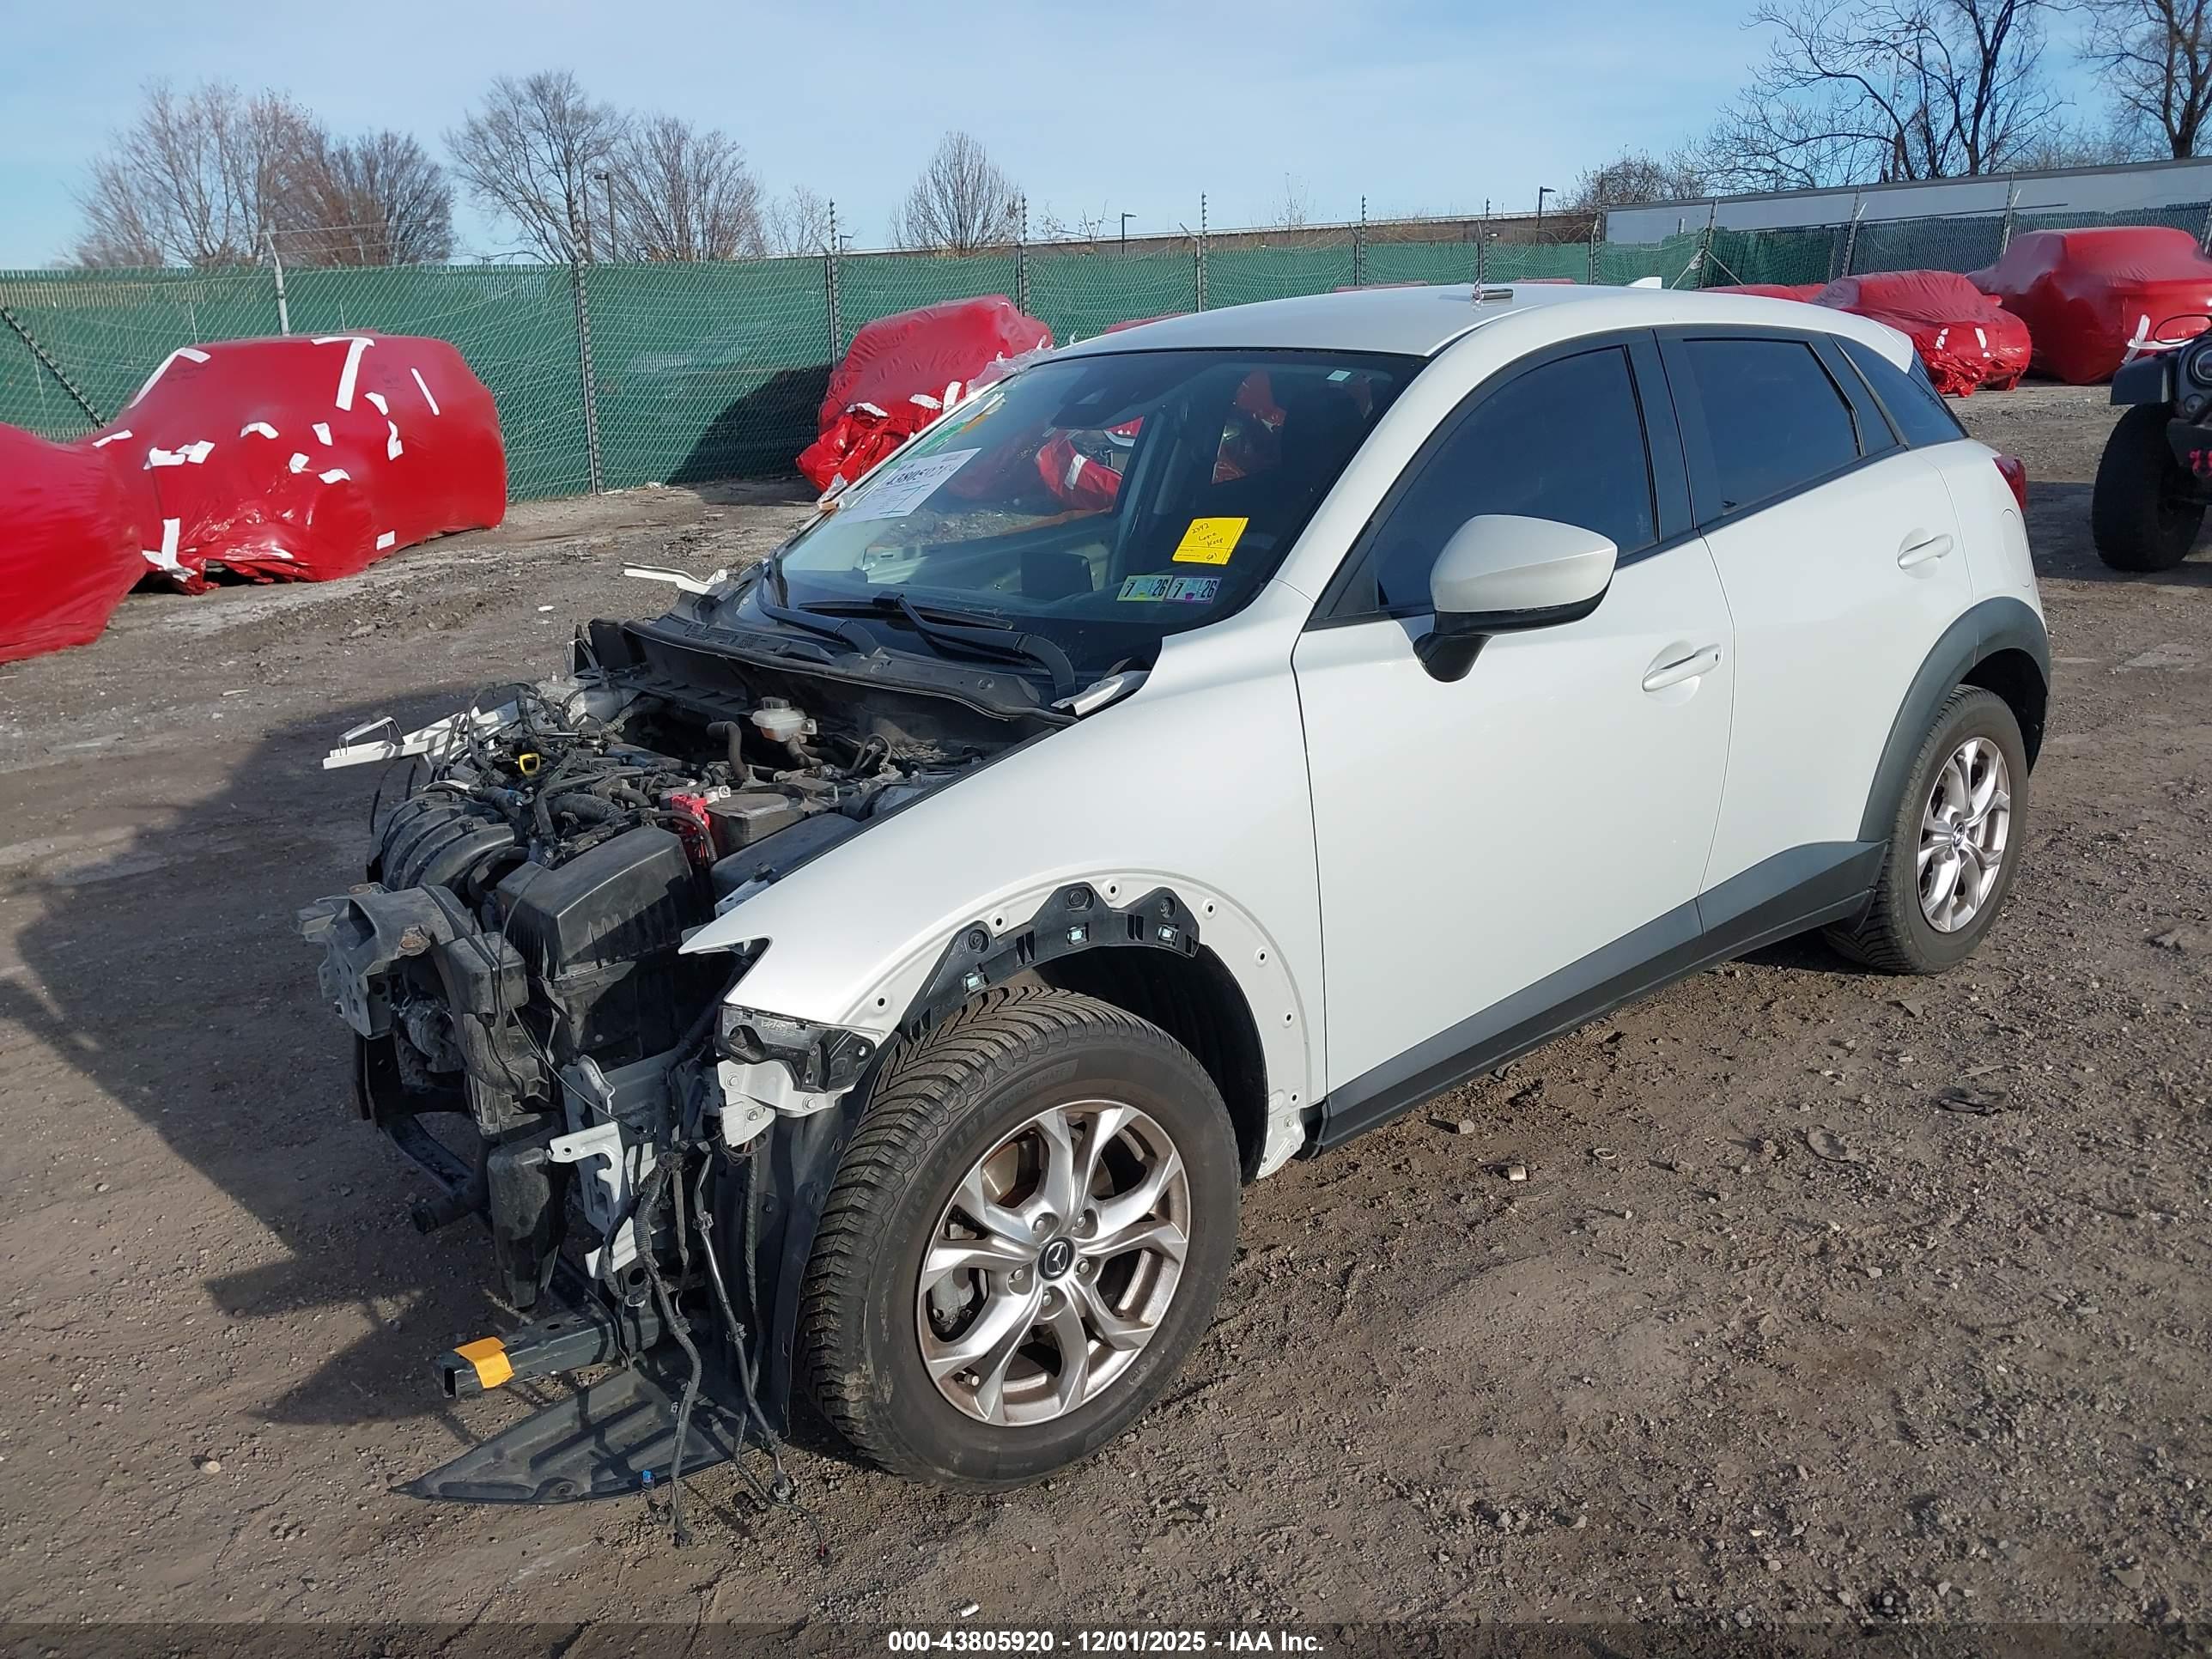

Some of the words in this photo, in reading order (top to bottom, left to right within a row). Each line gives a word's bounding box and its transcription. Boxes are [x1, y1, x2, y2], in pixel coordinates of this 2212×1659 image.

[1124, 582, 1136, 598] 7
[1152, 579, 1169, 597] 26
[1172, 582, 1185, 599] 7
[1200, 580, 1218, 599] 26
